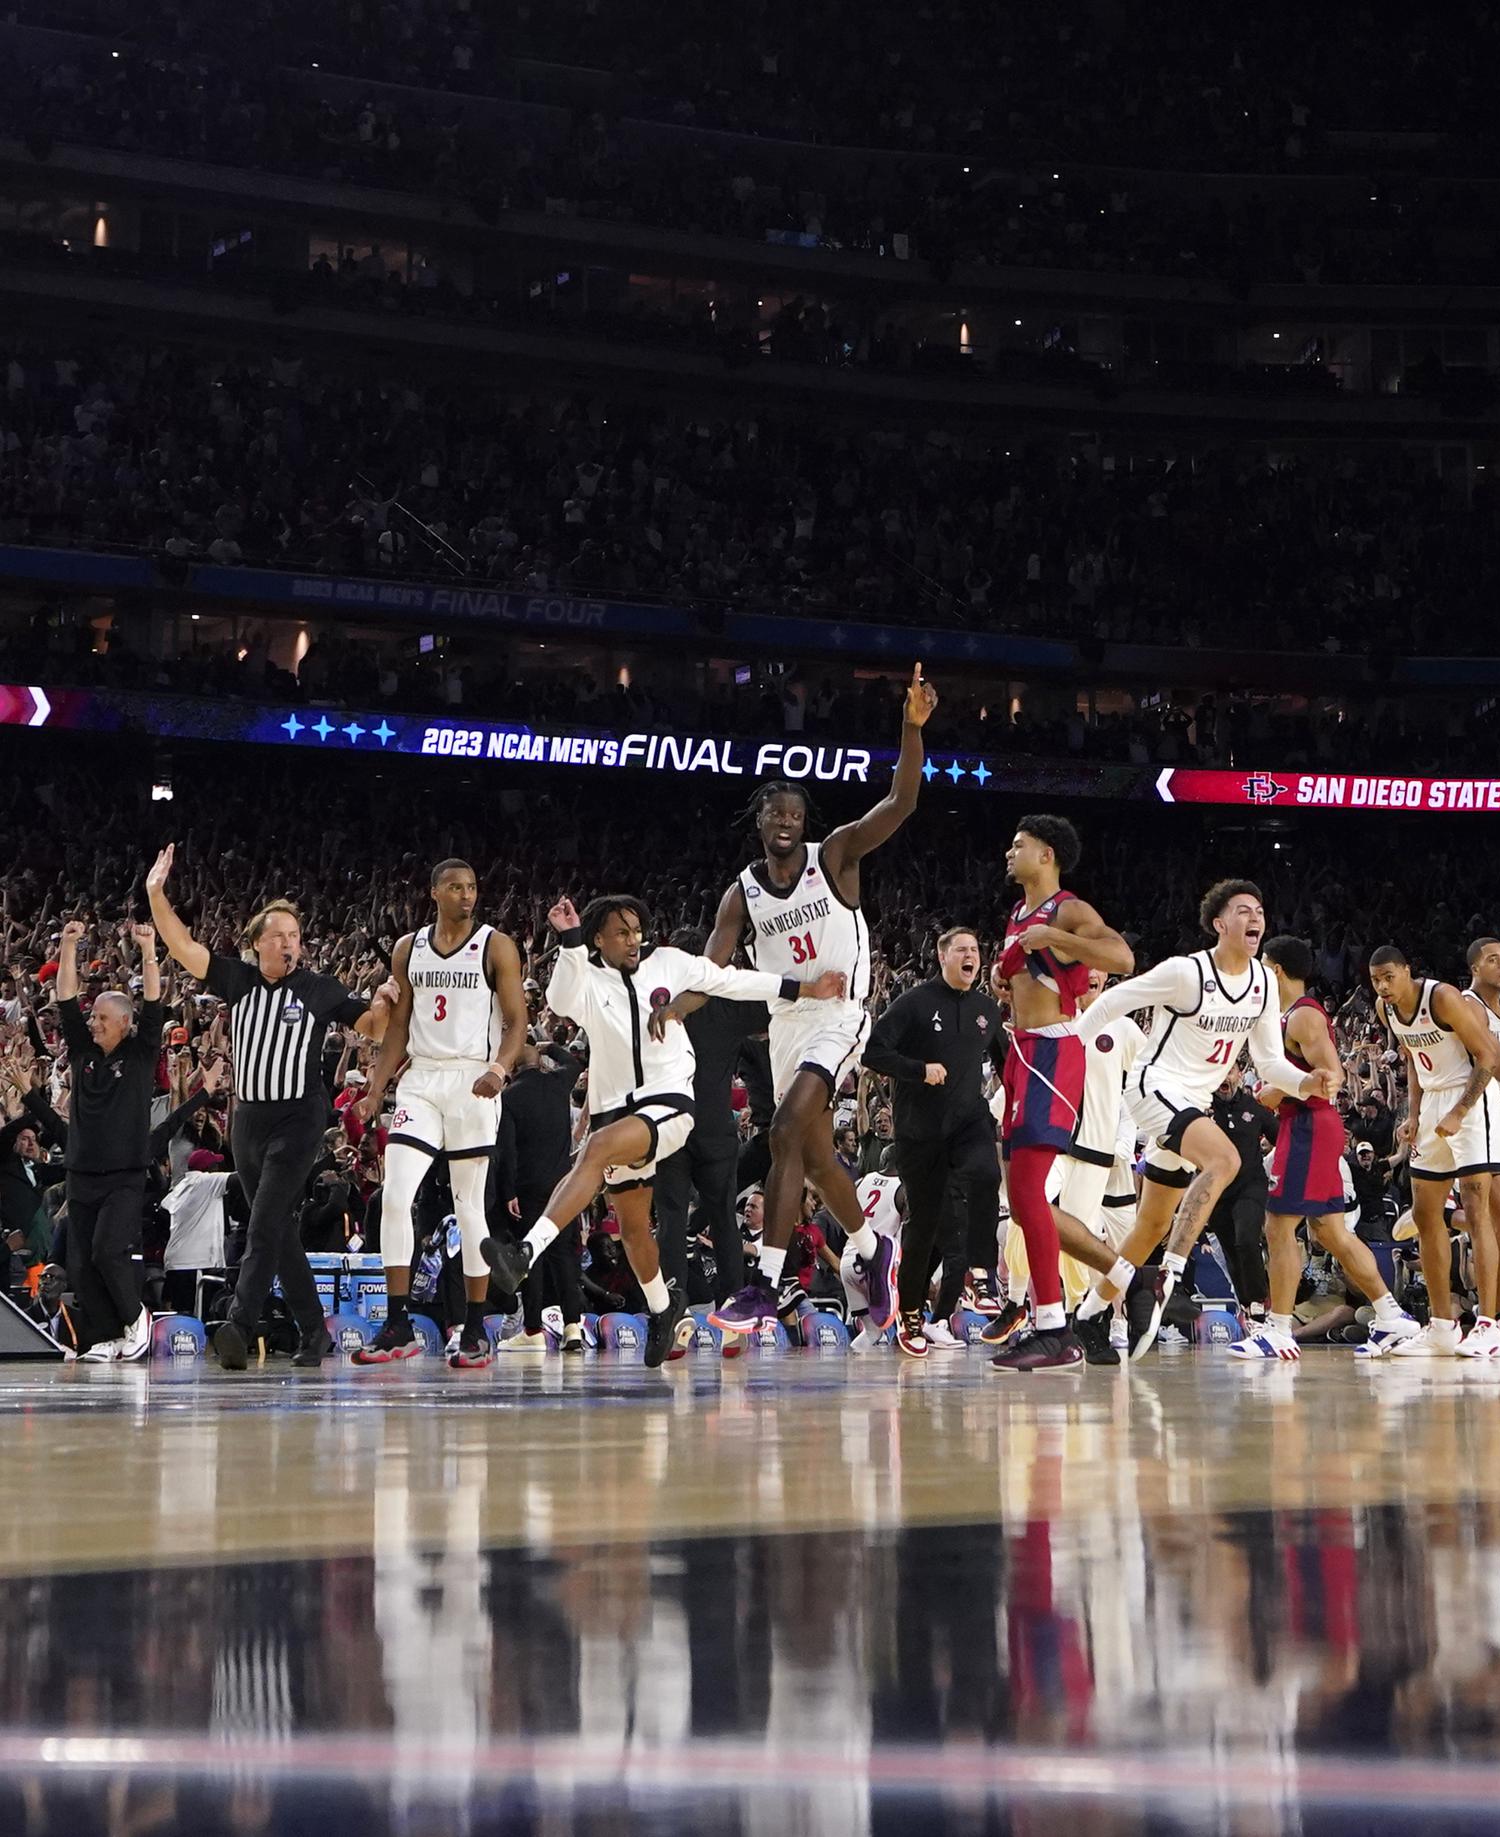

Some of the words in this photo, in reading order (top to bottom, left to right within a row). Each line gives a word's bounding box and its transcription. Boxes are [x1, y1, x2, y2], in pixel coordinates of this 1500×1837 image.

[431, 590, 518, 618] FINAL
[525, 599, 607, 625] FOUR
[422, 727, 482, 757] 2023
[486, 732, 546, 761] NCAA
[549, 737, 619, 766] MEN'S
[618, 733, 743, 775] FINAL
[754, 743, 871, 782] FOUR
[1296, 776, 1346, 805] SAN
[1351, 777, 1422, 807] DIEGO
[774, 908, 803, 934] DIEGO
[801, 897, 831, 923] STATE
[788, 931, 817, 964] 31
[425, 971, 451, 988] DIEGO
[452, 972, 480, 989] STATE
[434, 994, 447, 1021] 3
[1196, 1014, 1214, 1031] SAN
[1205, 1039, 1234, 1065] 21
[1420, 1030, 1445, 1047] STATE
[1418, 1051, 1433, 1072] 0
[863, 1189, 881, 1218] 2
